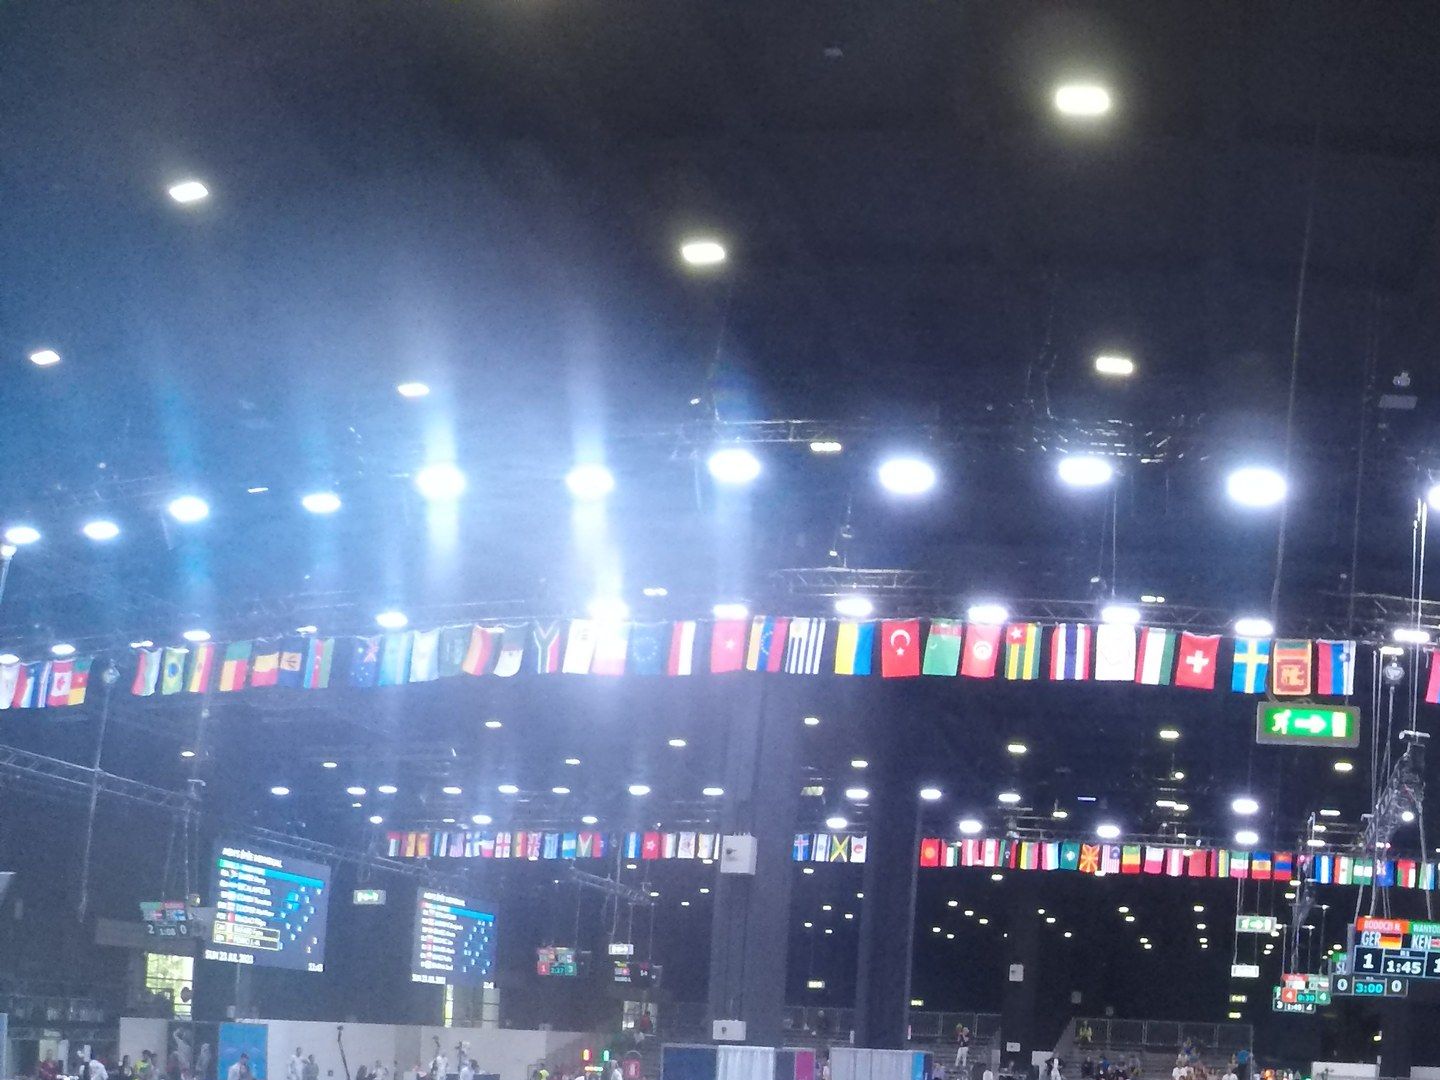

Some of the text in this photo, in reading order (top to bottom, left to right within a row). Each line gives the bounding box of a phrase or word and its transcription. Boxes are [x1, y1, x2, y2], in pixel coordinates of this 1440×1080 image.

[148, 924, 155, 934] 2
[180, 924, 187, 934] 0
[1361, 931, 1381, 947] GER
[1411, 934, 1432, 950] KEN
[1363, 953, 1374, 969] 1
[1386, 960, 1421, 974] 1:45
[1337, 979, 1348, 991] 0
[1355, 982, 1384, 994] 3:00
[1391, 980, 1401, 992] 0
